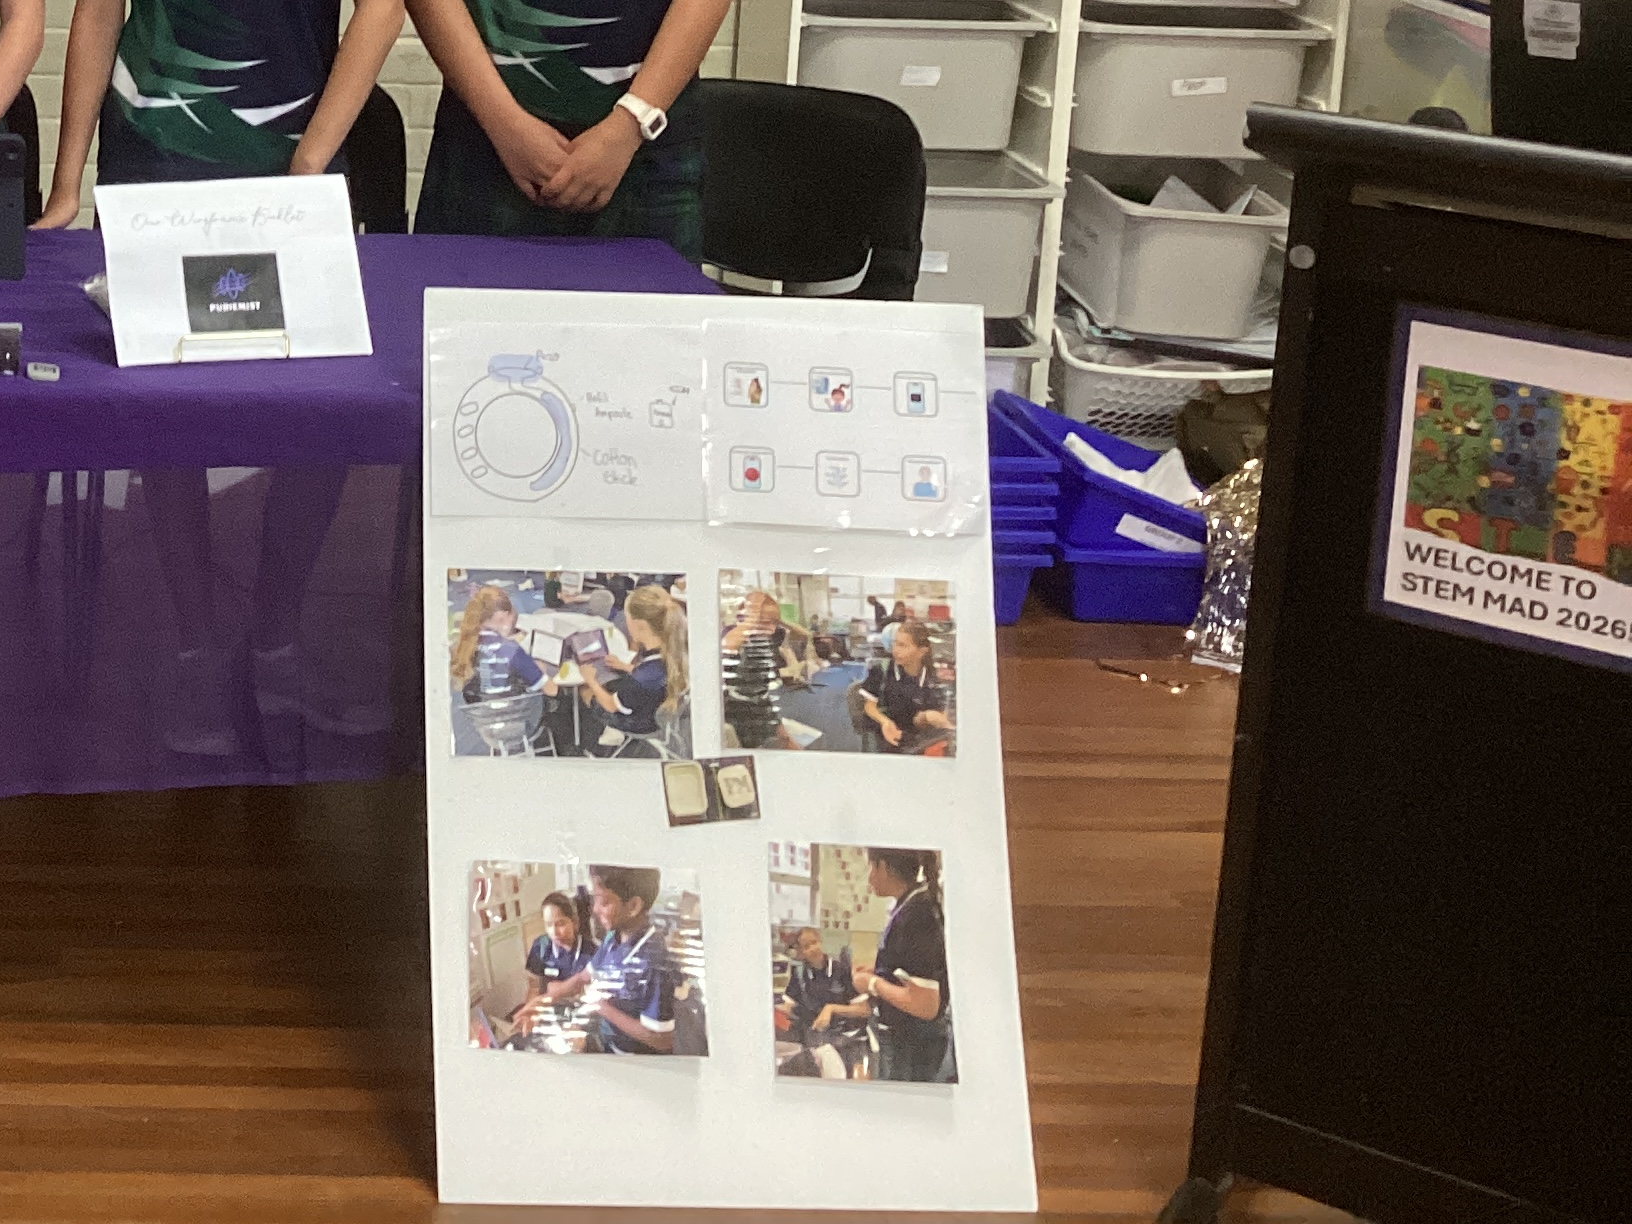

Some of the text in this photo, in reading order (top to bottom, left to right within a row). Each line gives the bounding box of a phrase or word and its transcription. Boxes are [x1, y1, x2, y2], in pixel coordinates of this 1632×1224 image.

[1401, 572, 1475, 606] STEM
[1483, 590, 1549, 621] MAD
[1404, 541, 1597, 601] WELCOME TO
